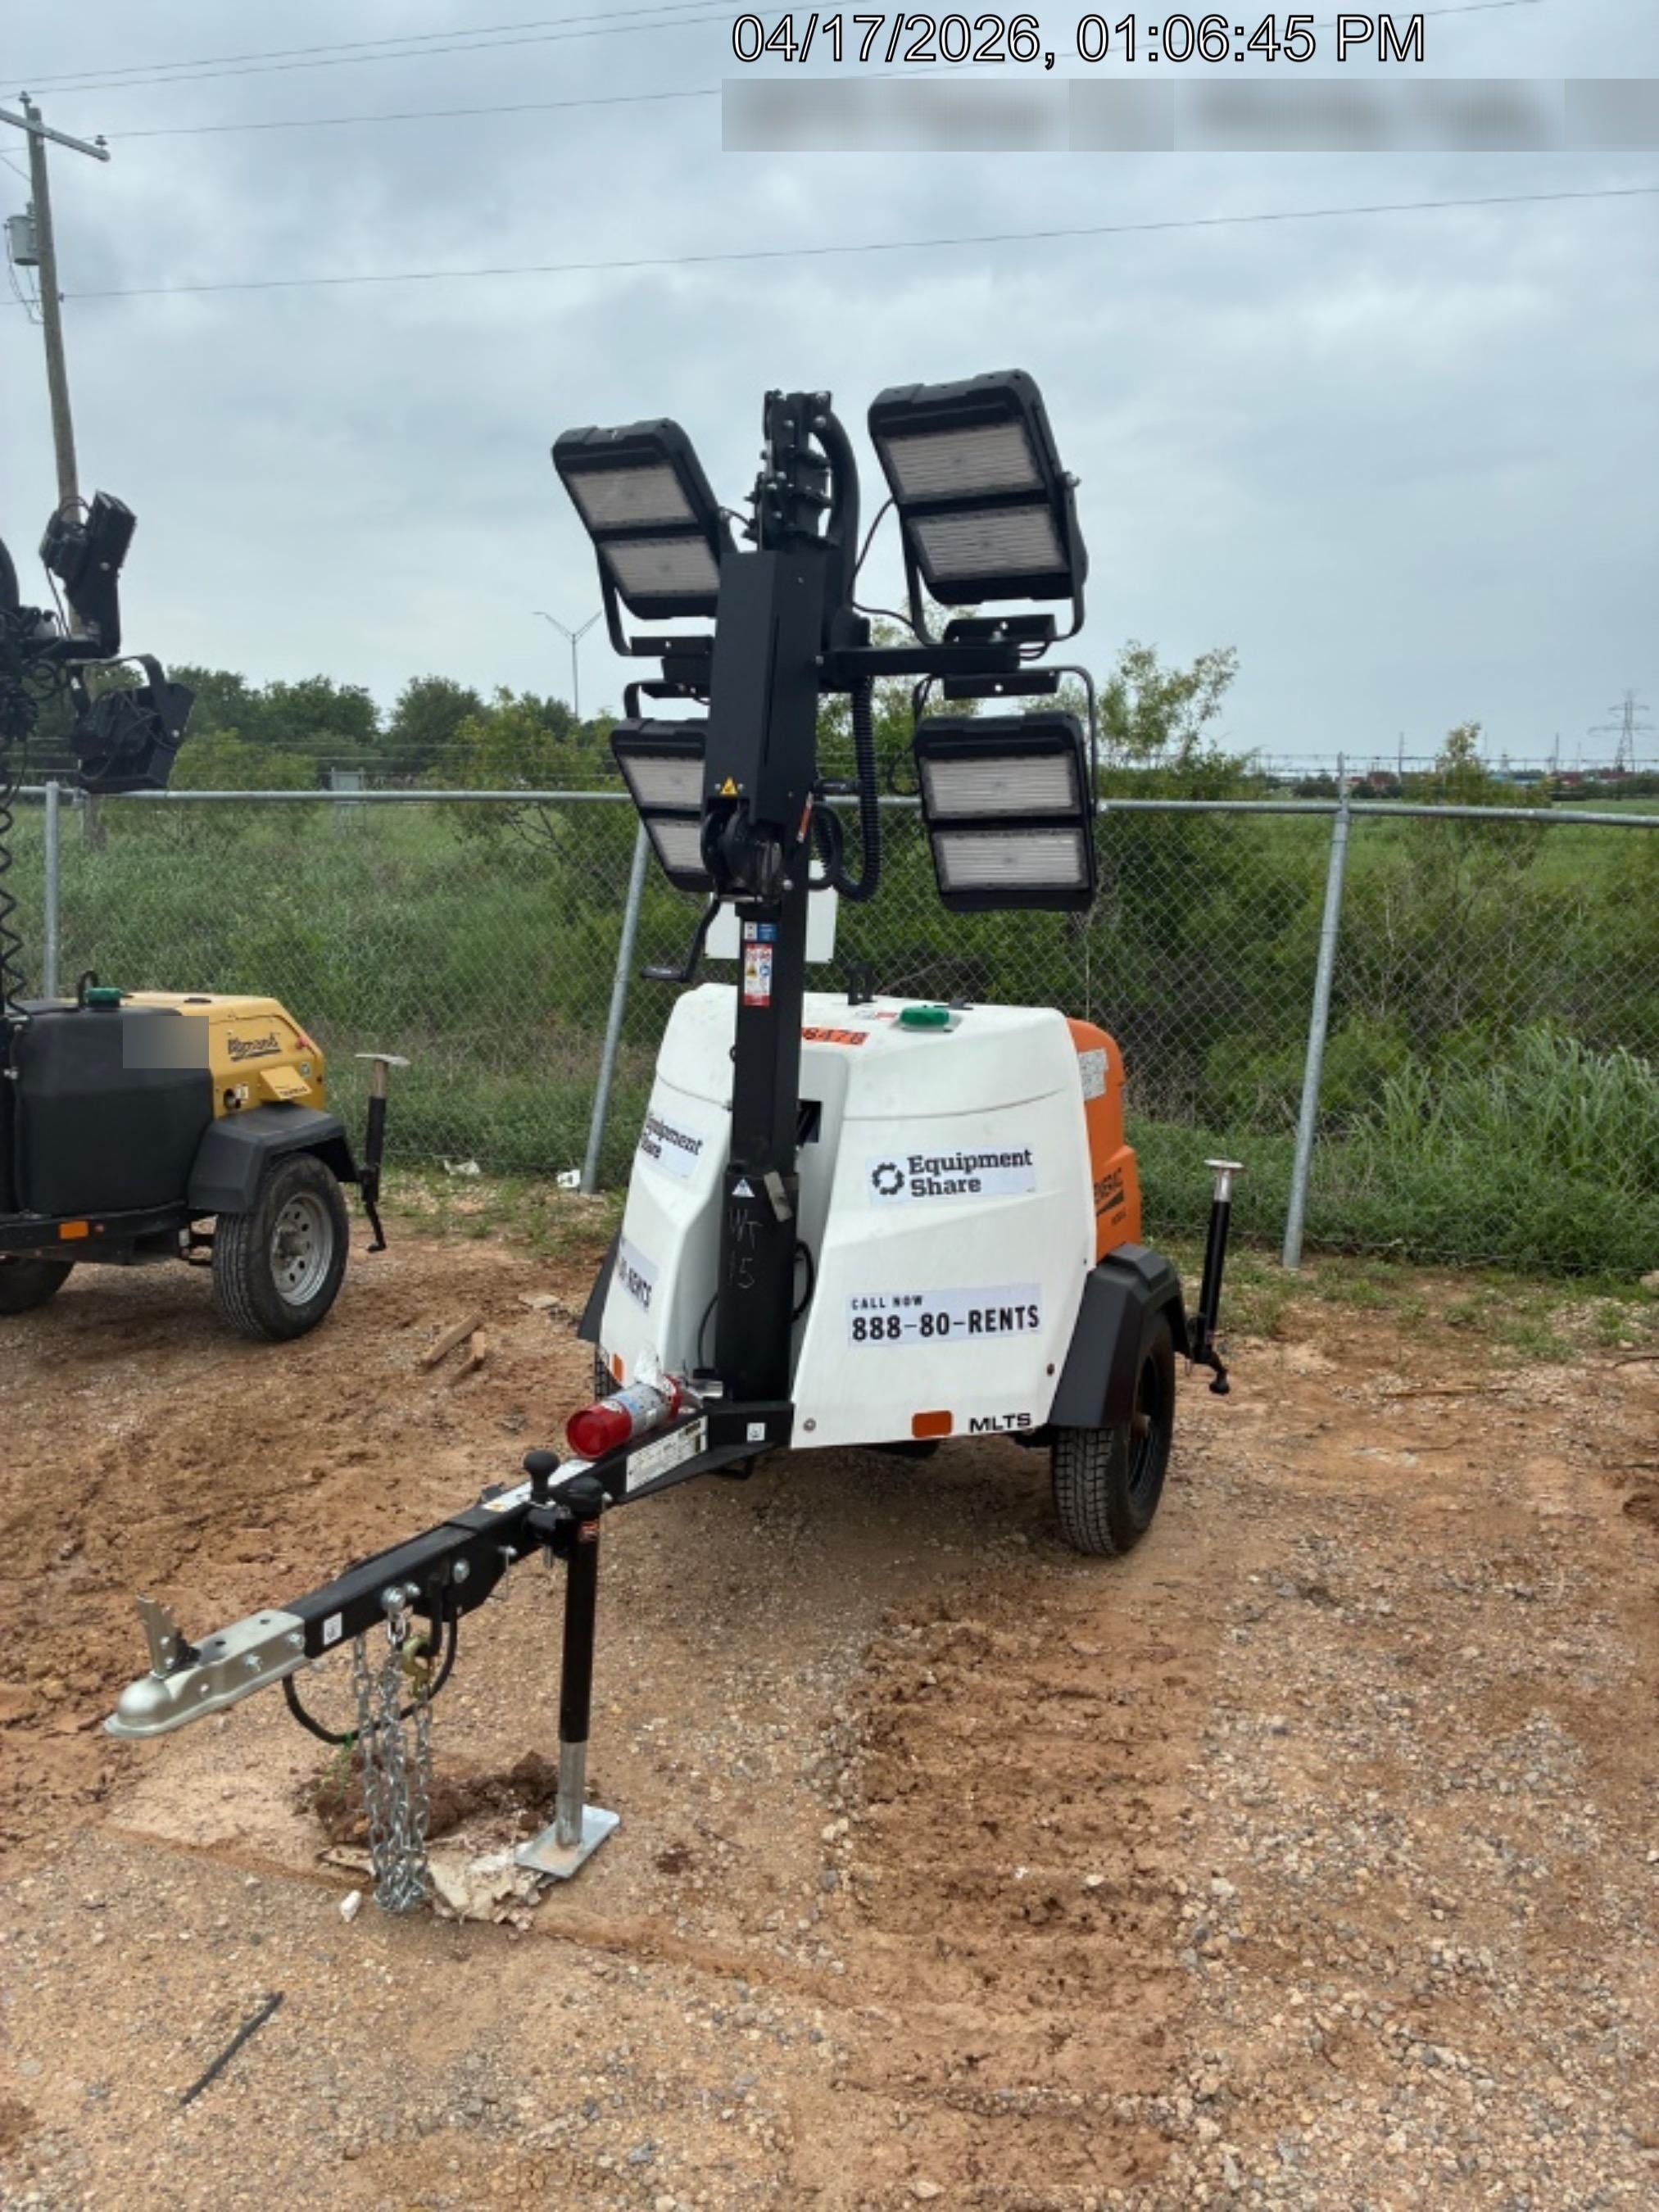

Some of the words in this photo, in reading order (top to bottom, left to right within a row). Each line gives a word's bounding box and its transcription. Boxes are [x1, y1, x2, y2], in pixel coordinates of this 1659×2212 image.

[907, 1149, 1033, 1177] Equipment
[909, 1177, 982, 1197] Share
[852, 1297, 886, 1311] CALL
[892, 1294, 923, 1308] NOW
[852, 1304, 1040, 1342] 888-80-RENTS
[969, 1412, 1031, 1434] MLTS
